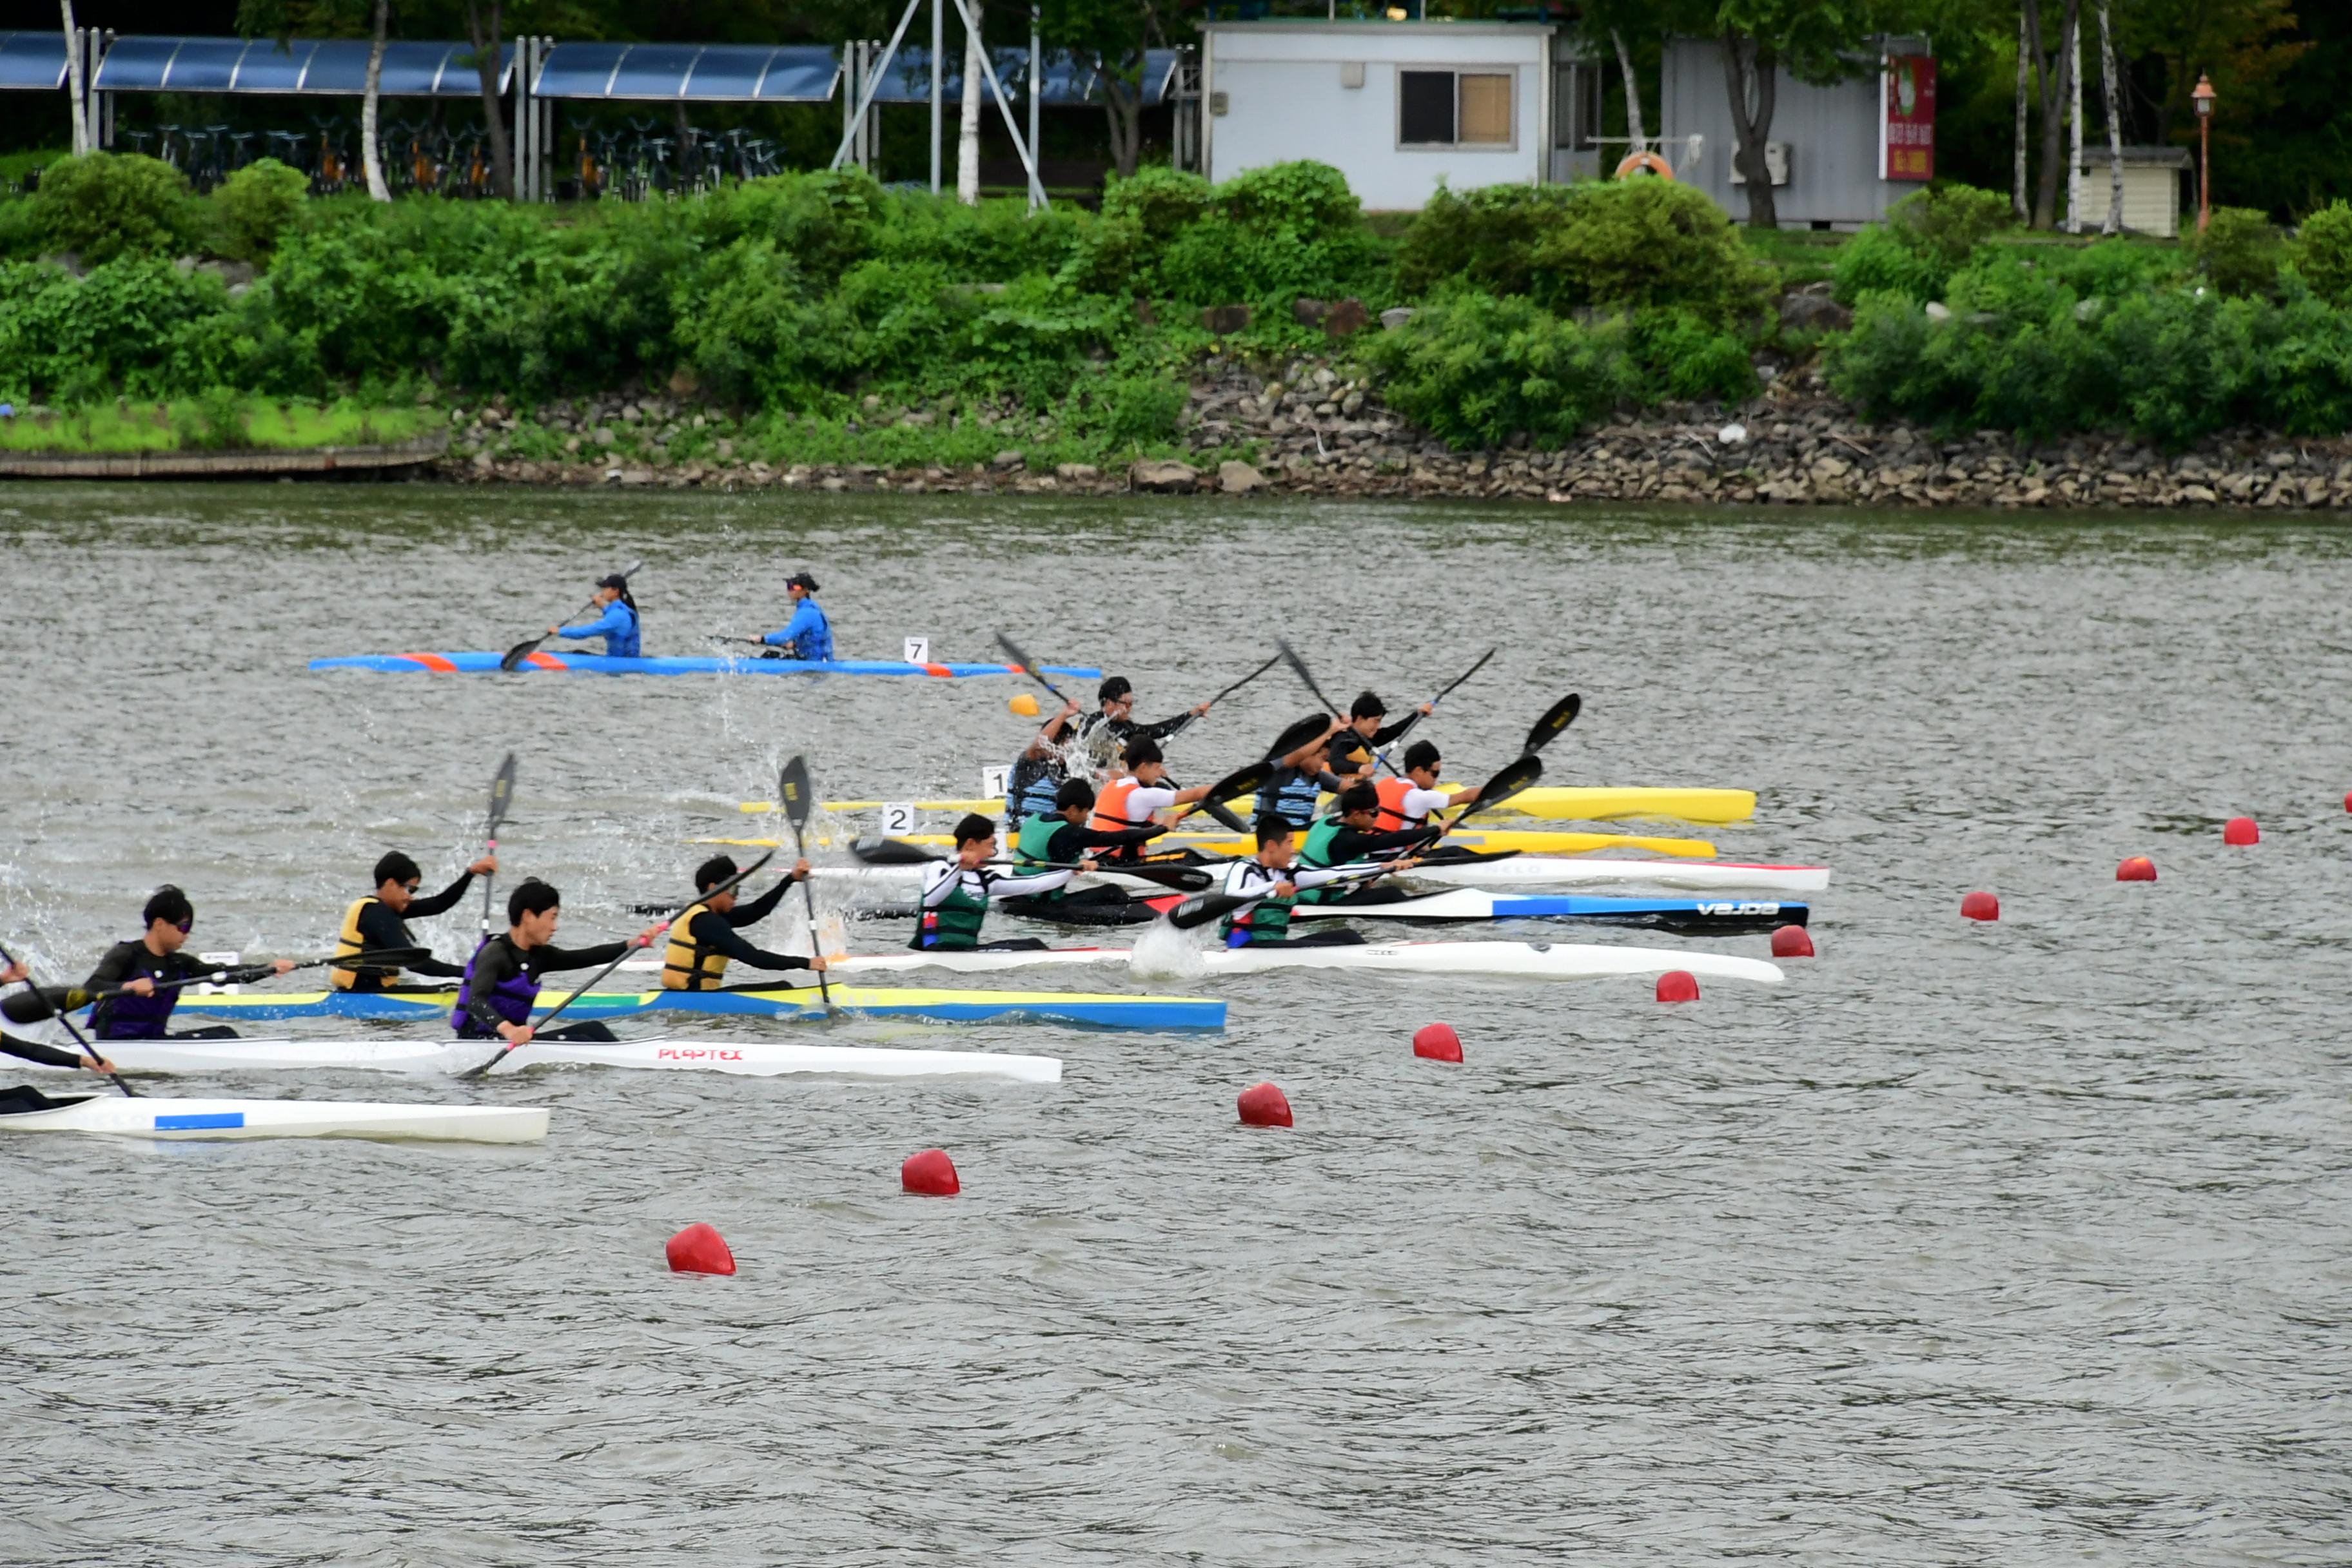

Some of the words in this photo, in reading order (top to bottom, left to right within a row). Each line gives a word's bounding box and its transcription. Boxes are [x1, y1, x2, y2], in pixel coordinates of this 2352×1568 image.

[910, 643, 922, 660] 7
[993, 773, 1003, 792] 1
[890, 809, 906, 830] 2
